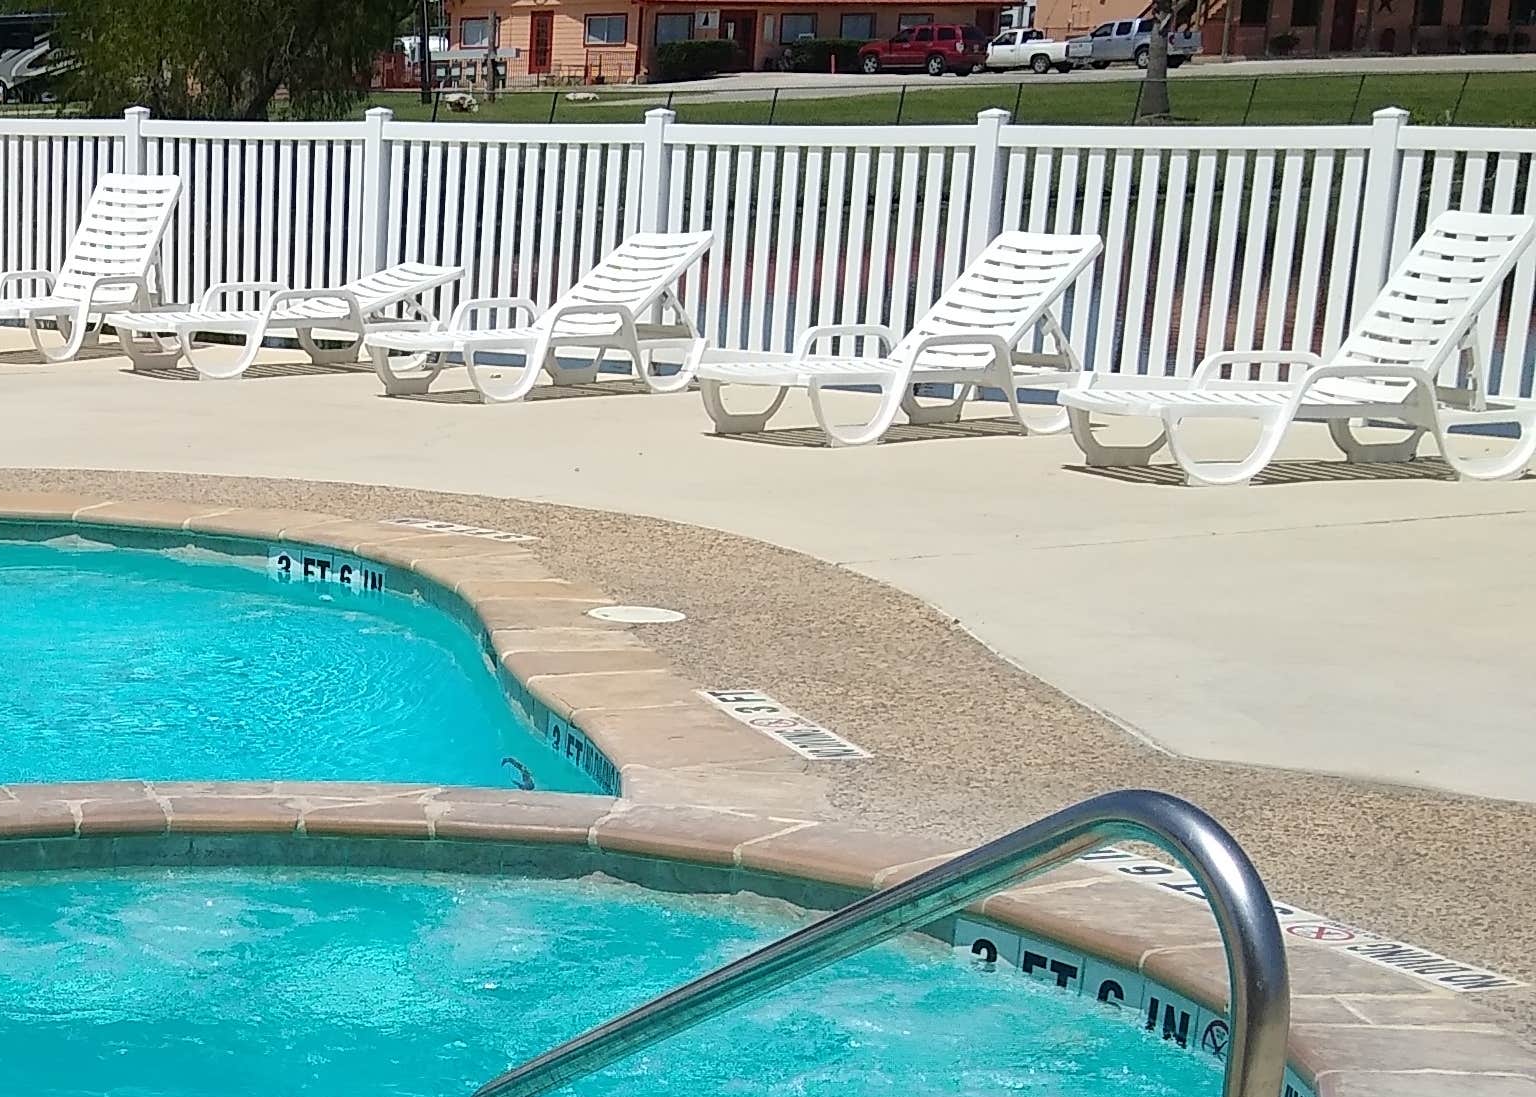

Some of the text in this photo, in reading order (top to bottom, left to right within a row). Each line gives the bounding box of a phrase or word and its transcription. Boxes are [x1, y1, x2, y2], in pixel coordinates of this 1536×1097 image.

[303, 556, 331, 580] FT
[566, 732, 584, 768] FT
[1346, 943, 1472, 975] DIVING
[1438, 973, 1520, 990] NO
[1145, 996, 1191, 1050] IN
